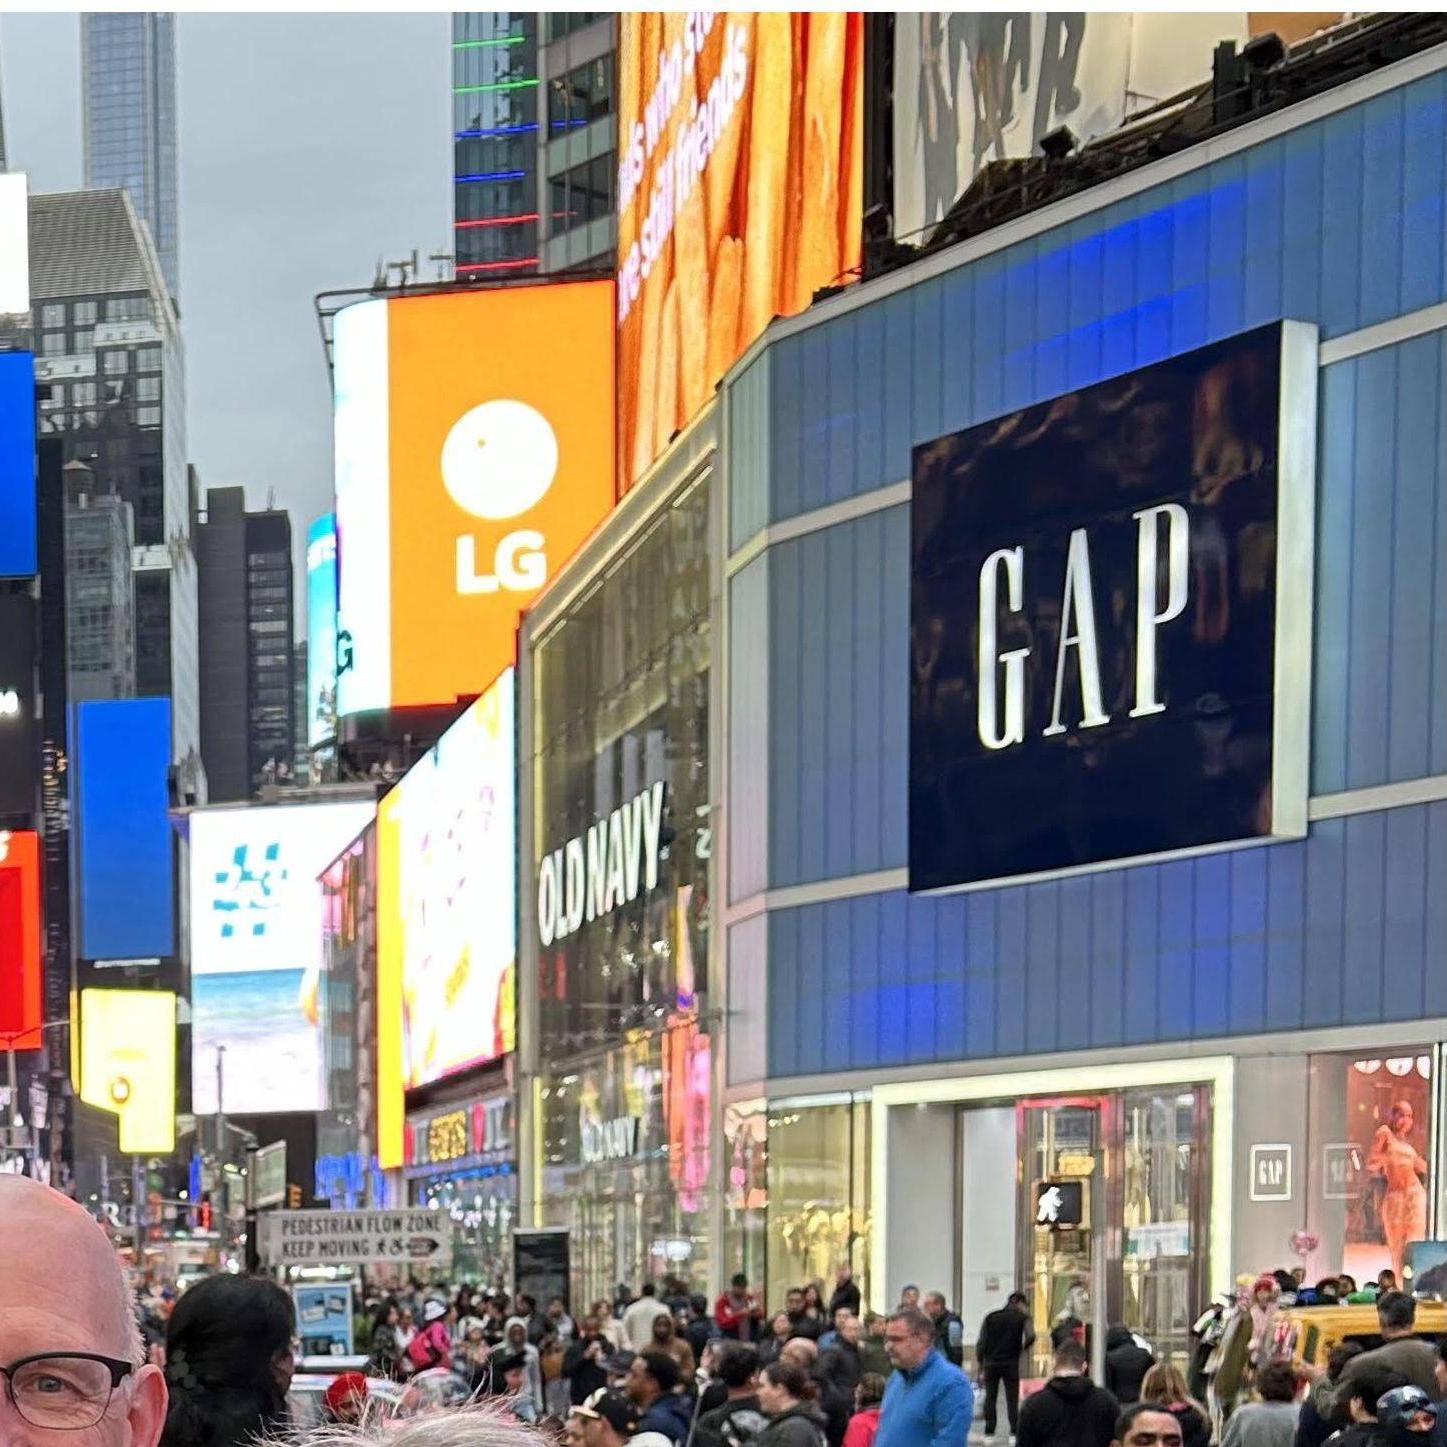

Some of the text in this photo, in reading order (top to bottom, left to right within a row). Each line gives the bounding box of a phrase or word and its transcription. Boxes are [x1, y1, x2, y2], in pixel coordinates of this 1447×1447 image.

[455, 529, 547, 595] LG
[977, 502, 1191, 750] GAP
[538, 836, 585, 947] OLD
[586, 780, 665, 923] NAVY
[1258, 1159, 1283, 1186] GAP
[282, 1214, 441, 1236] PEDESTRIAN FLOW ZONE
[282, 1239, 370, 1258] KEEP MOVING
